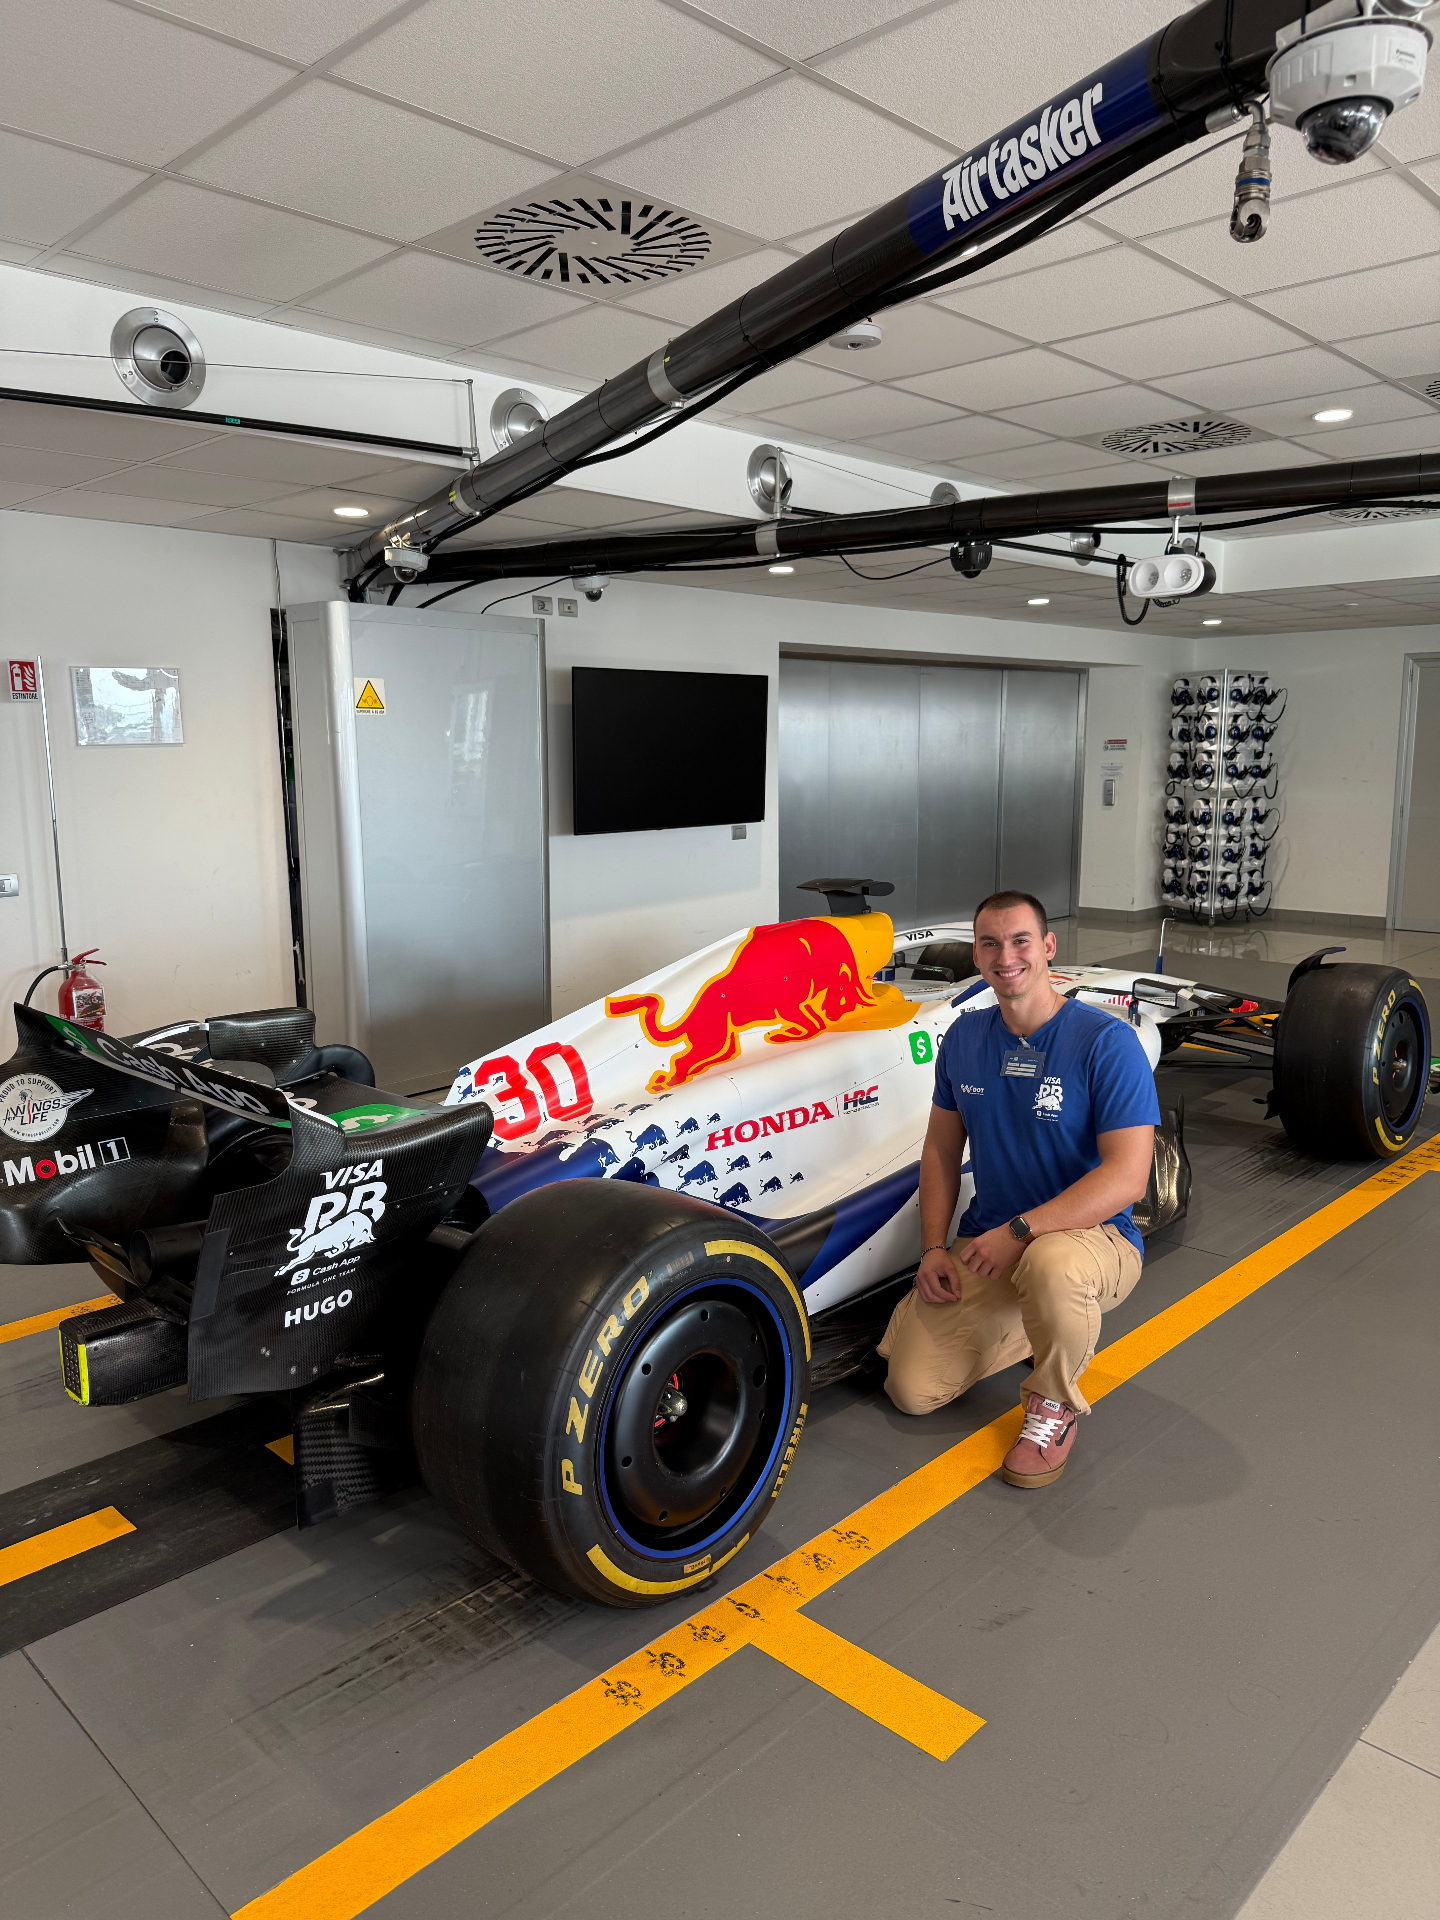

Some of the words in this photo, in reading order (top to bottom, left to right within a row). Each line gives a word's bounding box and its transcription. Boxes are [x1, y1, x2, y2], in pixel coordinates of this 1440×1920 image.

[942, 82, 1103, 231] Airtasker
[12, 692, 38, 700] ESTINTORE
[905, 930, 934, 941] VISA
[1373, 989, 1396, 1061] ZERO
[28, 1078, 57, 1095] SUPPORT
[97, 1037, 190, 1088] Cash
[182, 1067, 270, 1116] App
[1043, 1076, 1061, 1085] VISA
[1372, 1066, 1379, 1086] P
[474, 1042, 594, 1141] 30
[10, 1099, 61, 1117] WINGS
[20, 1111, 48, 1125] LIFE
[704, 1101, 835, 1152] HONDA
[843, 1085, 878, 1110] HRC
[3, 1144, 96, 1187] Mobil
[320, 1159, 383, 1189] VISA
[312, 1261, 338, 1276] Cash
[339, 1255, 361, 1268] App
[286, 1281, 320, 1295] FORMULA
[322, 1274, 336, 1283] ONE
[339, 1267, 356, 1277] TEAM
[284, 1289, 353, 1328] HUGO
[565, 1275, 650, 1444] ZERO
[561, 1458, 583, 1496] P
